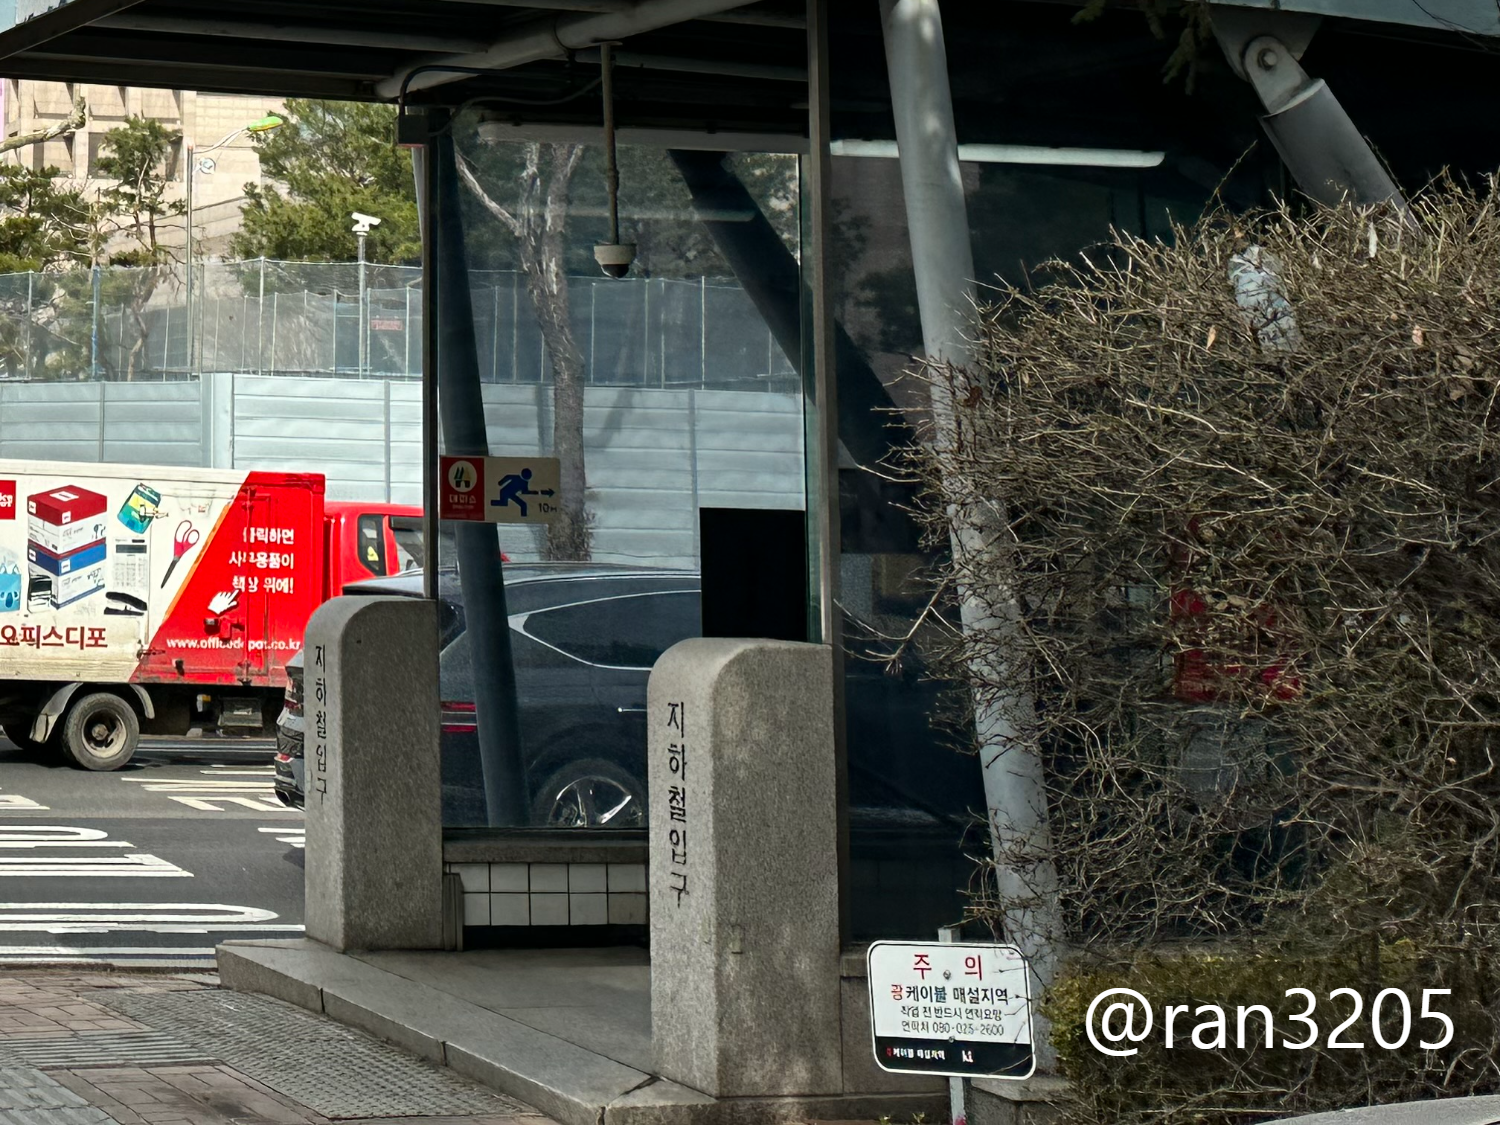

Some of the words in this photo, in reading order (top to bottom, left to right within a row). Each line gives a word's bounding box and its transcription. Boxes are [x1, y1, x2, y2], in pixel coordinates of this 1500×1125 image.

[263, 577, 294, 594] 위에!
[667, 701, 689, 908] 지하철입구
[953, 988, 1008, 1005] 매설지역
[934, 1007, 962, 1019] 반드시
